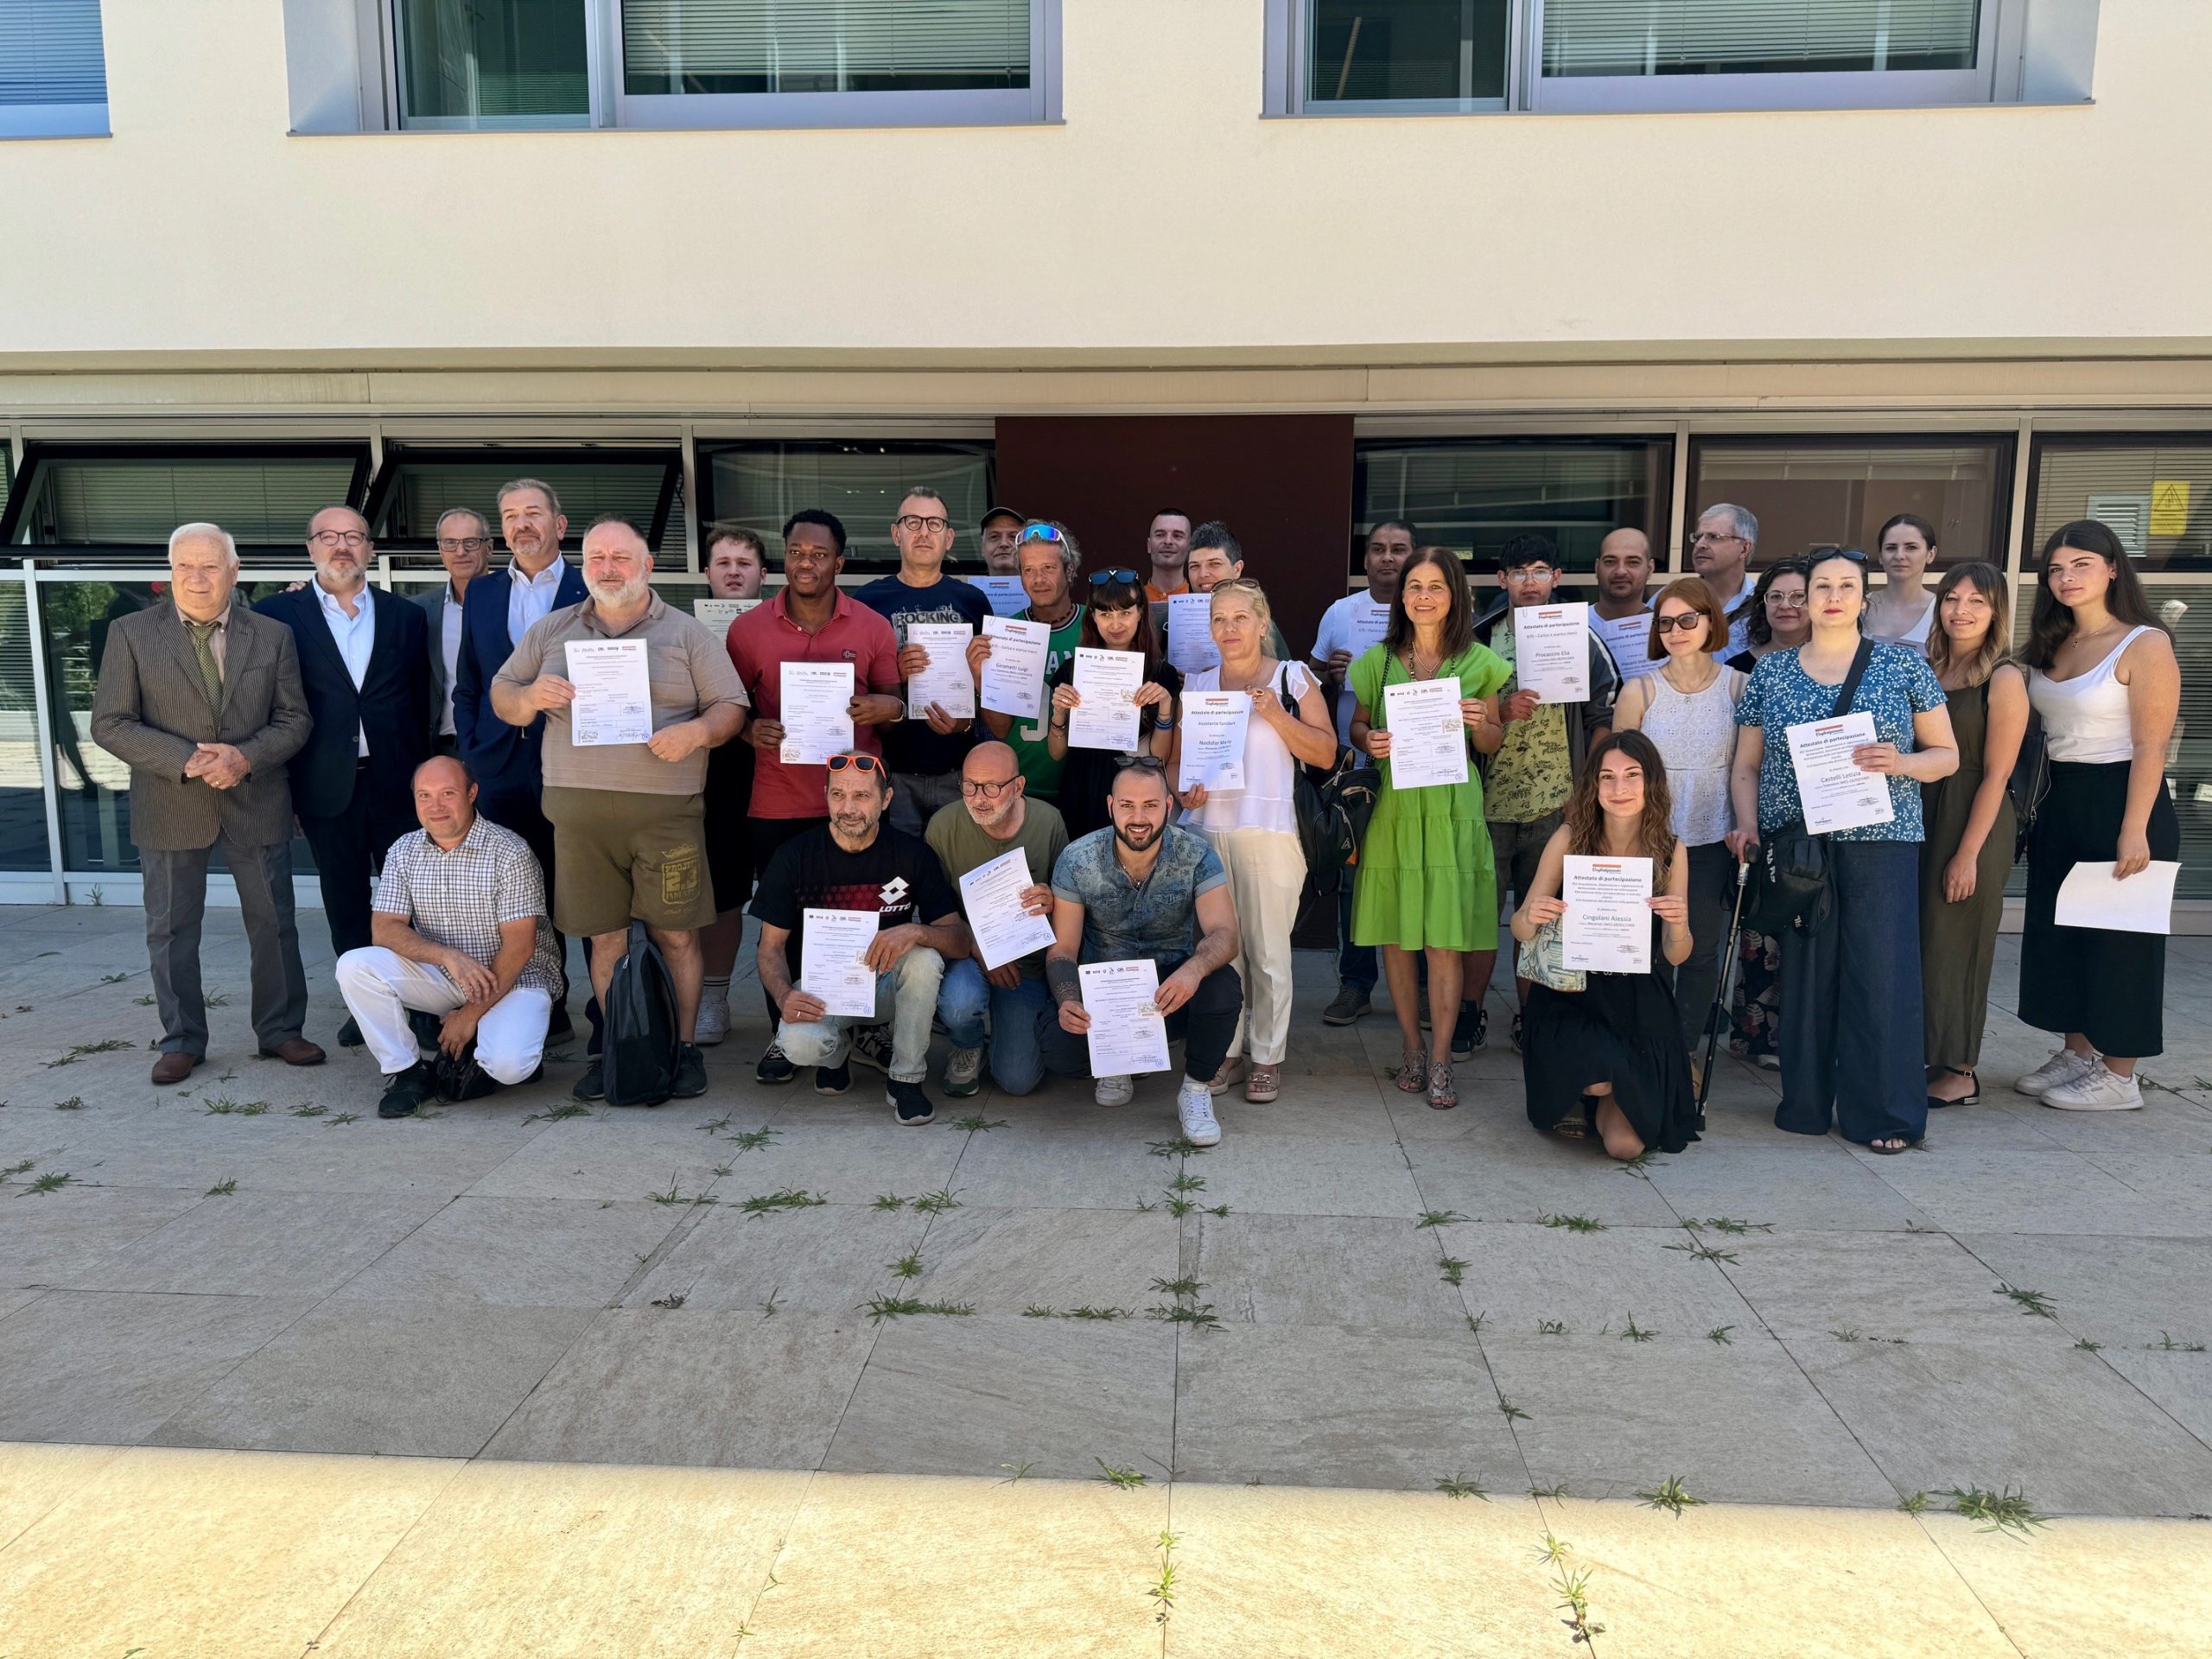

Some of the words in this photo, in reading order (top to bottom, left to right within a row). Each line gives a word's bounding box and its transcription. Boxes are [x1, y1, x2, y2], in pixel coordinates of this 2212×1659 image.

[896, 612, 959, 623] ROCKING
[1829, 732, 1866, 743] partecipazione
[879, 901, 912, 912] LOTTO
